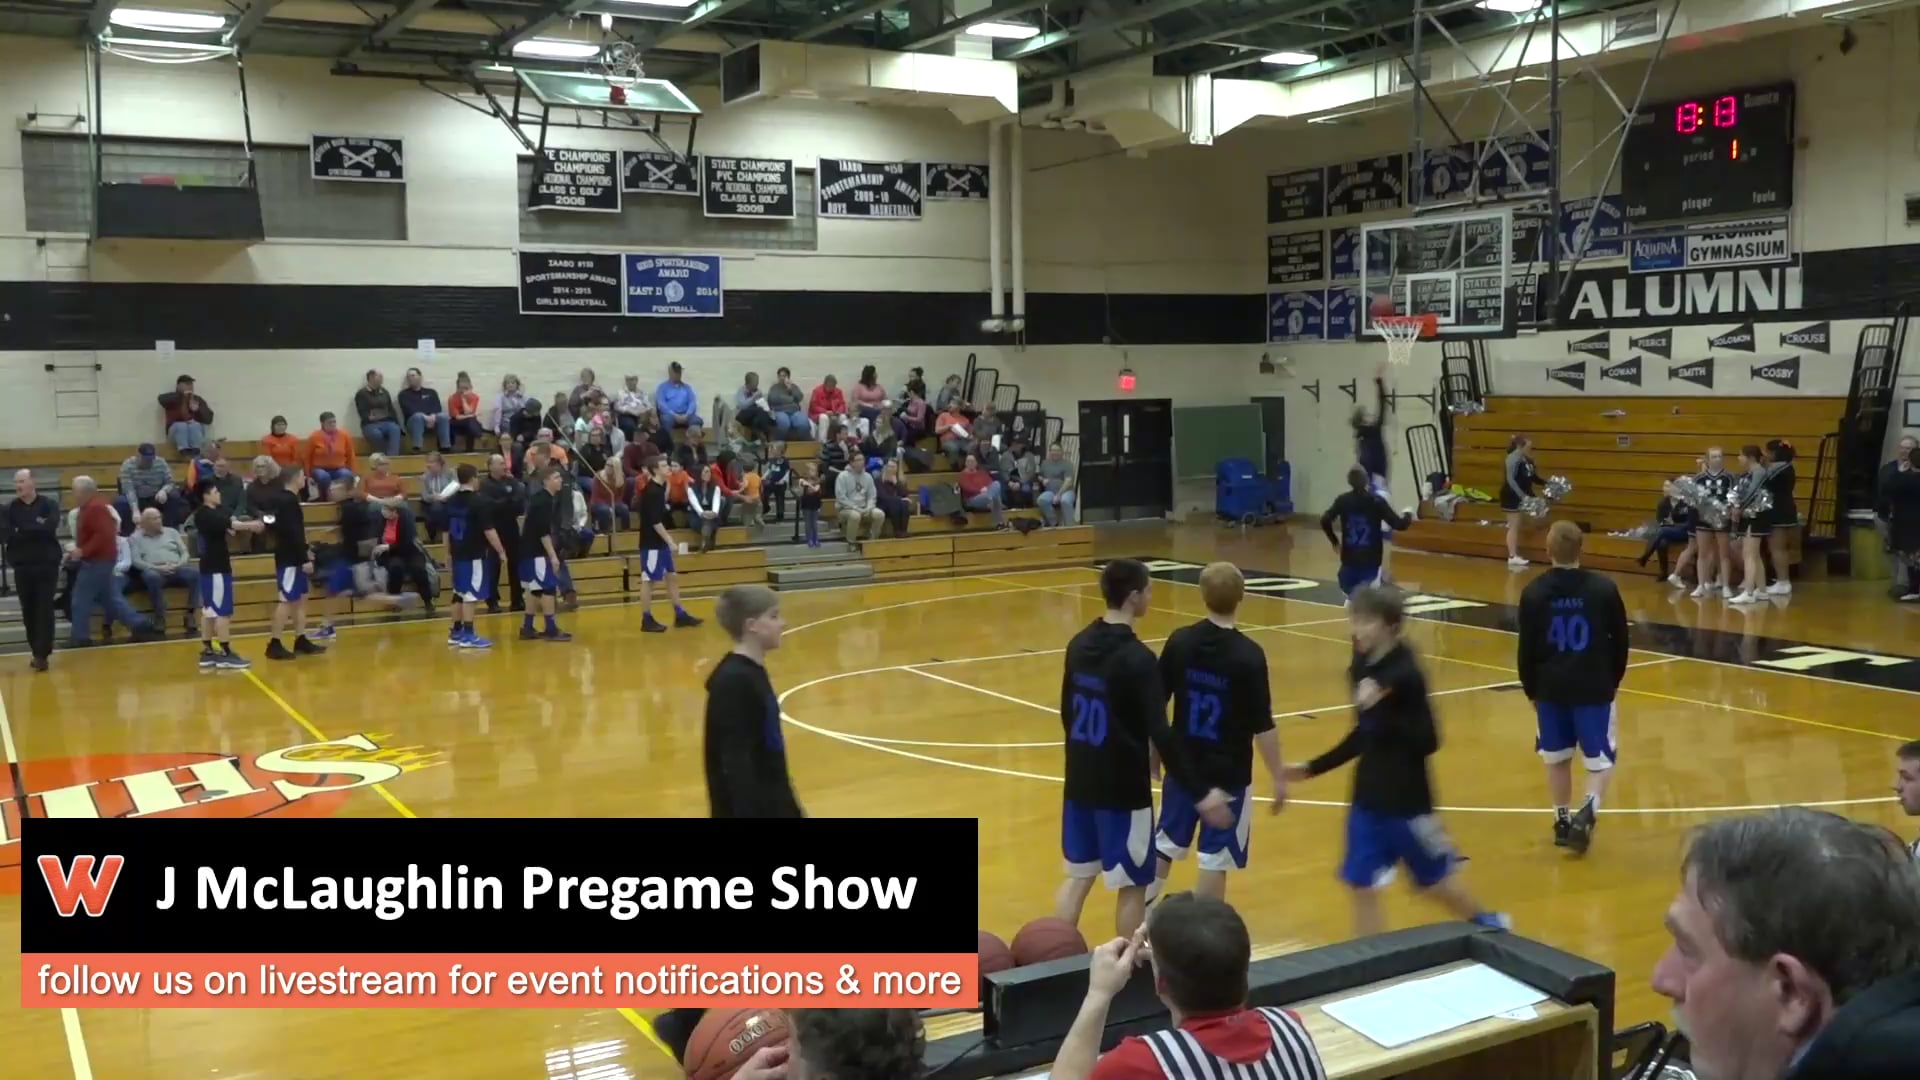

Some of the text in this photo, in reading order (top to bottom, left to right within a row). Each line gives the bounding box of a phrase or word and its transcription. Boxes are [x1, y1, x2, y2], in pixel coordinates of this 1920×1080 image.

[1731, 138, 1739, 160] 1
[560, 151, 611, 162] CHAMPIONS
[1683, 150, 1714, 166] period
[554, 162, 605, 174] CHAMPIONS
[711, 159, 786, 173] STATE CHAMPIONS
[576, 174, 612, 187] CHAMPIONS
[716, 171, 781, 183] PVC CHAMPIONS
[538, 185, 603, 196] CLASS C GOLF
[711, 182, 788, 195] PVC REGIONAL CHAMPIONS
[821, 173, 885, 200] SPORTSMANSHIP
[894, 179, 921, 203] AWARD
[720, 194, 780, 204] CLASS C GOLF
[1753, 189, 1776, 203] fouls
[827, 202, 917, 216] BOYS BASKETBALL
[1682, 197, 1713, 213] player
[1634, 238, 1678, 259] AQUAFINA
[1690, 239, 1785, 262] GYMNASIUM
[655, 258, 710, 272] SPORTSMANSHIP
[525, 272, 617, 286] SPORTSMANSHIP AWARD
[658, 268, 689, 278] AWARD
[629, 286, 719, 296] EAST D 2014
[1569, 266, 1804, 320] ALUMNI
[536, 298, 608, 307] GIRLS BASKETBALL
[652, 305, 697, 313] FOOTBALL
[1638, 338, 1667, 347] PIERCE
[1713, 334, 1751, 346] SOLOMON
[1786, 333, 1826, 343] CROUSE
[1608, 367, 1637, 376] COWAN
[1678, 367, 1707, 377] SMITH
[1761, 368, 1794, 378] COSBY
[1547, 614, 1590, 652] 40
[1070, 693, 1107, 747] 20
[1188, 690, 1222, 741] 12
